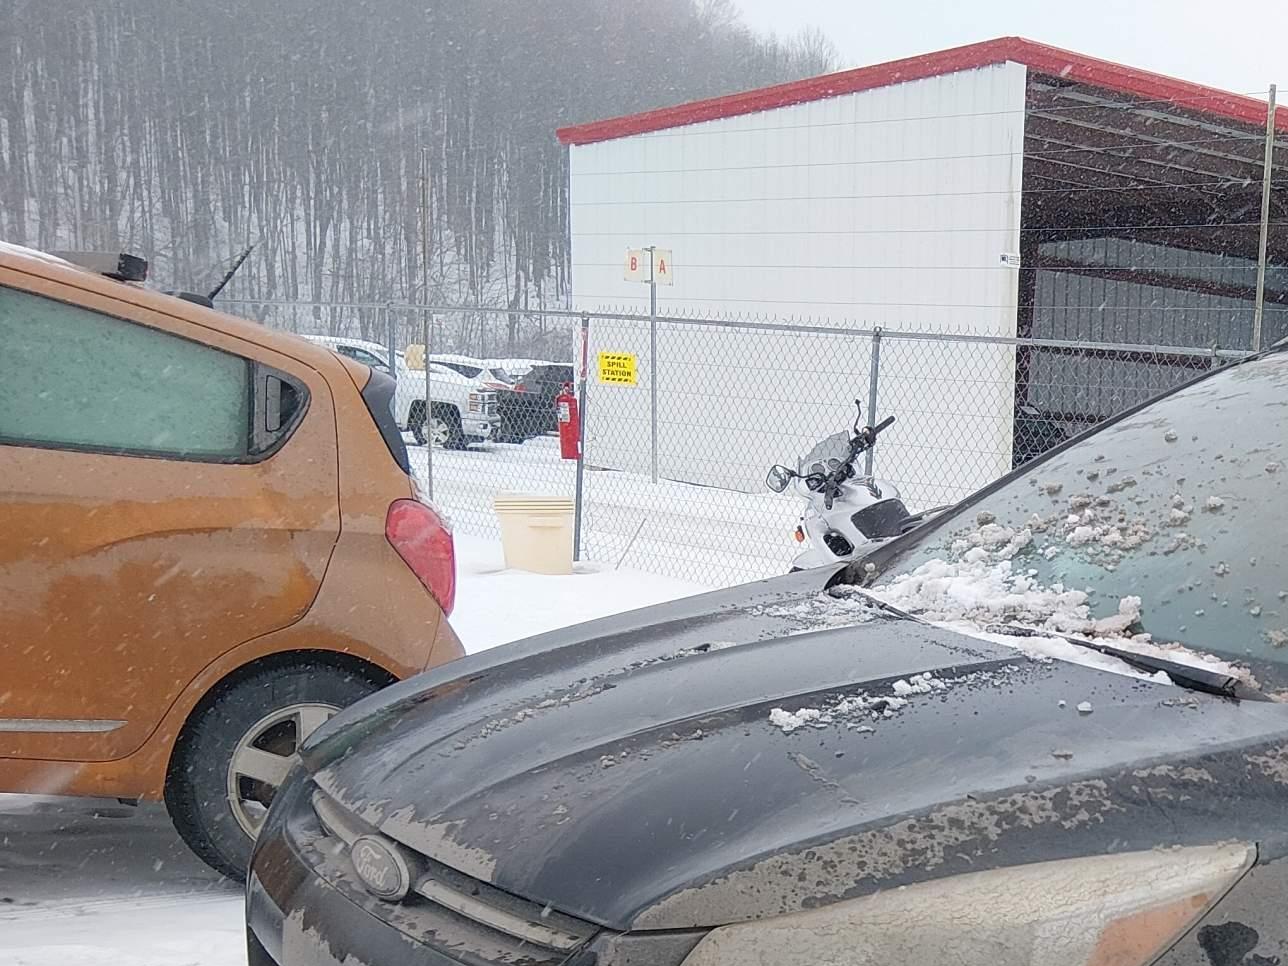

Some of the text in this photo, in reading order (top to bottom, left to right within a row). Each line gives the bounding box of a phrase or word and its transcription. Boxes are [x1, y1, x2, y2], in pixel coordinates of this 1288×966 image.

[630, 257, 638, 271] B
[659, 260, 667, 274] A
[607, 361, 627, 369] SPILL
[602, 369, 632, 377] STATION
[356, 845, 389, 888] Ford
